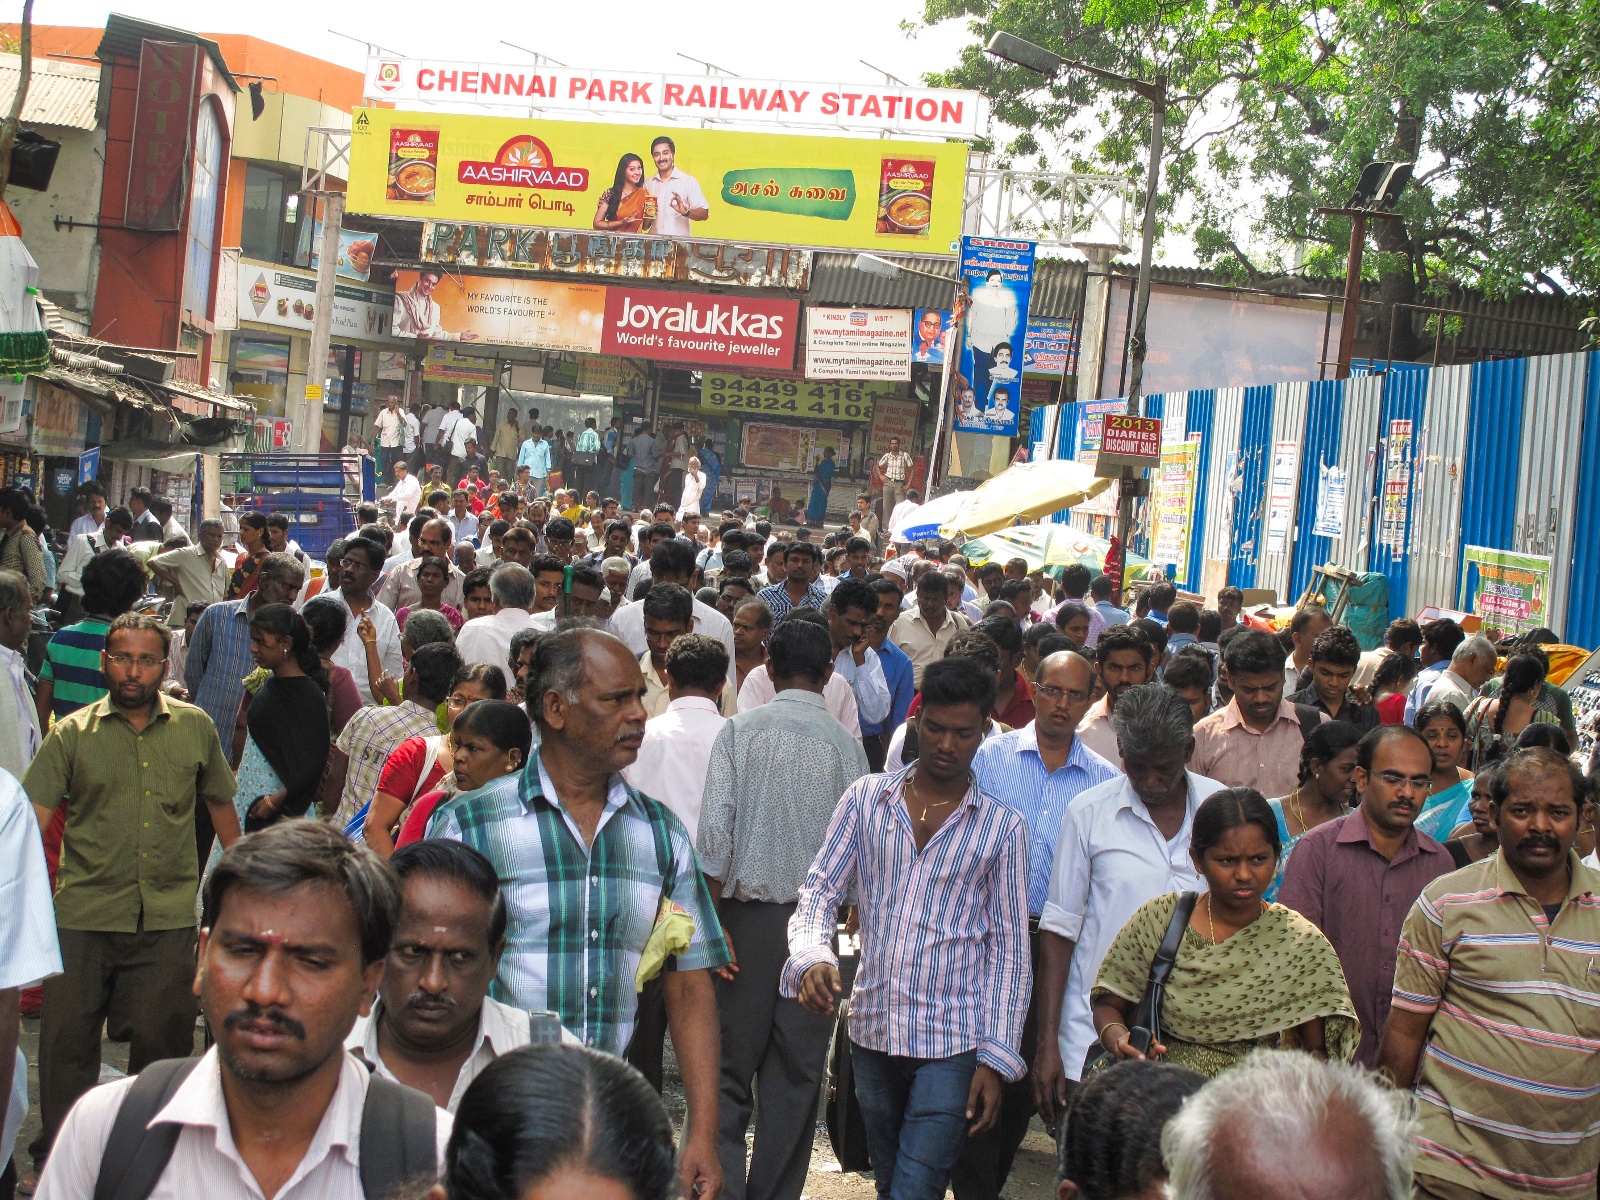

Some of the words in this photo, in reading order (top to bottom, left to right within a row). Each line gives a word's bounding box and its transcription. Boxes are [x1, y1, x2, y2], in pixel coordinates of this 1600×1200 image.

[416, 68, 556, 98] CHENNAI
[569, 77, 653, 105] PARK
[663, 83, 810, 112] RAILWAY
[820, 92, 963, 124] STATION
[462, 165, 584, 187] AASHIRVAAD
[886, 171, 929, 179] AASHIRVAAD
[729, 179, 780, 197] அசல்
[788, 185, 847, 202] சுவை
[465, 190, 524, 208] சாம்பார்
[528, 193, 576, 217] பொடி
[432, 223, 536, 263] PARK
[467, 291, 478, 301] MY
[480, 293, 522, 304] FAVOURITE
[523, 295, 531, 305] IS
[532, 296, 548, 306] THE
[467, 305, 502, 315] WORLD'S
[503, 307, 546, 318] FAVOURITE
[616, 296, 784, 339] Joyalukkas
[616, 331, 664, 347] World's
[667, 334, 726, 352] favourite
[727, 340, 781, 356] jeweller
[812, 328, 907, 339] www.mytamilmagazine.net
[812, 357, 907, 367] www.mytamilmagazine.net
[710, 377, 799, 397] 94449
[807, 386, 894, 403] 4161
[709, 392, 799, 412] 92824
[1111, 415, 1155, 431] 2013
[1106, 429, 1157, 441] DIARIES
[1105, 438, 1140, 453] DISCOUNT
[1140, 441, 1157, 455] SALE
